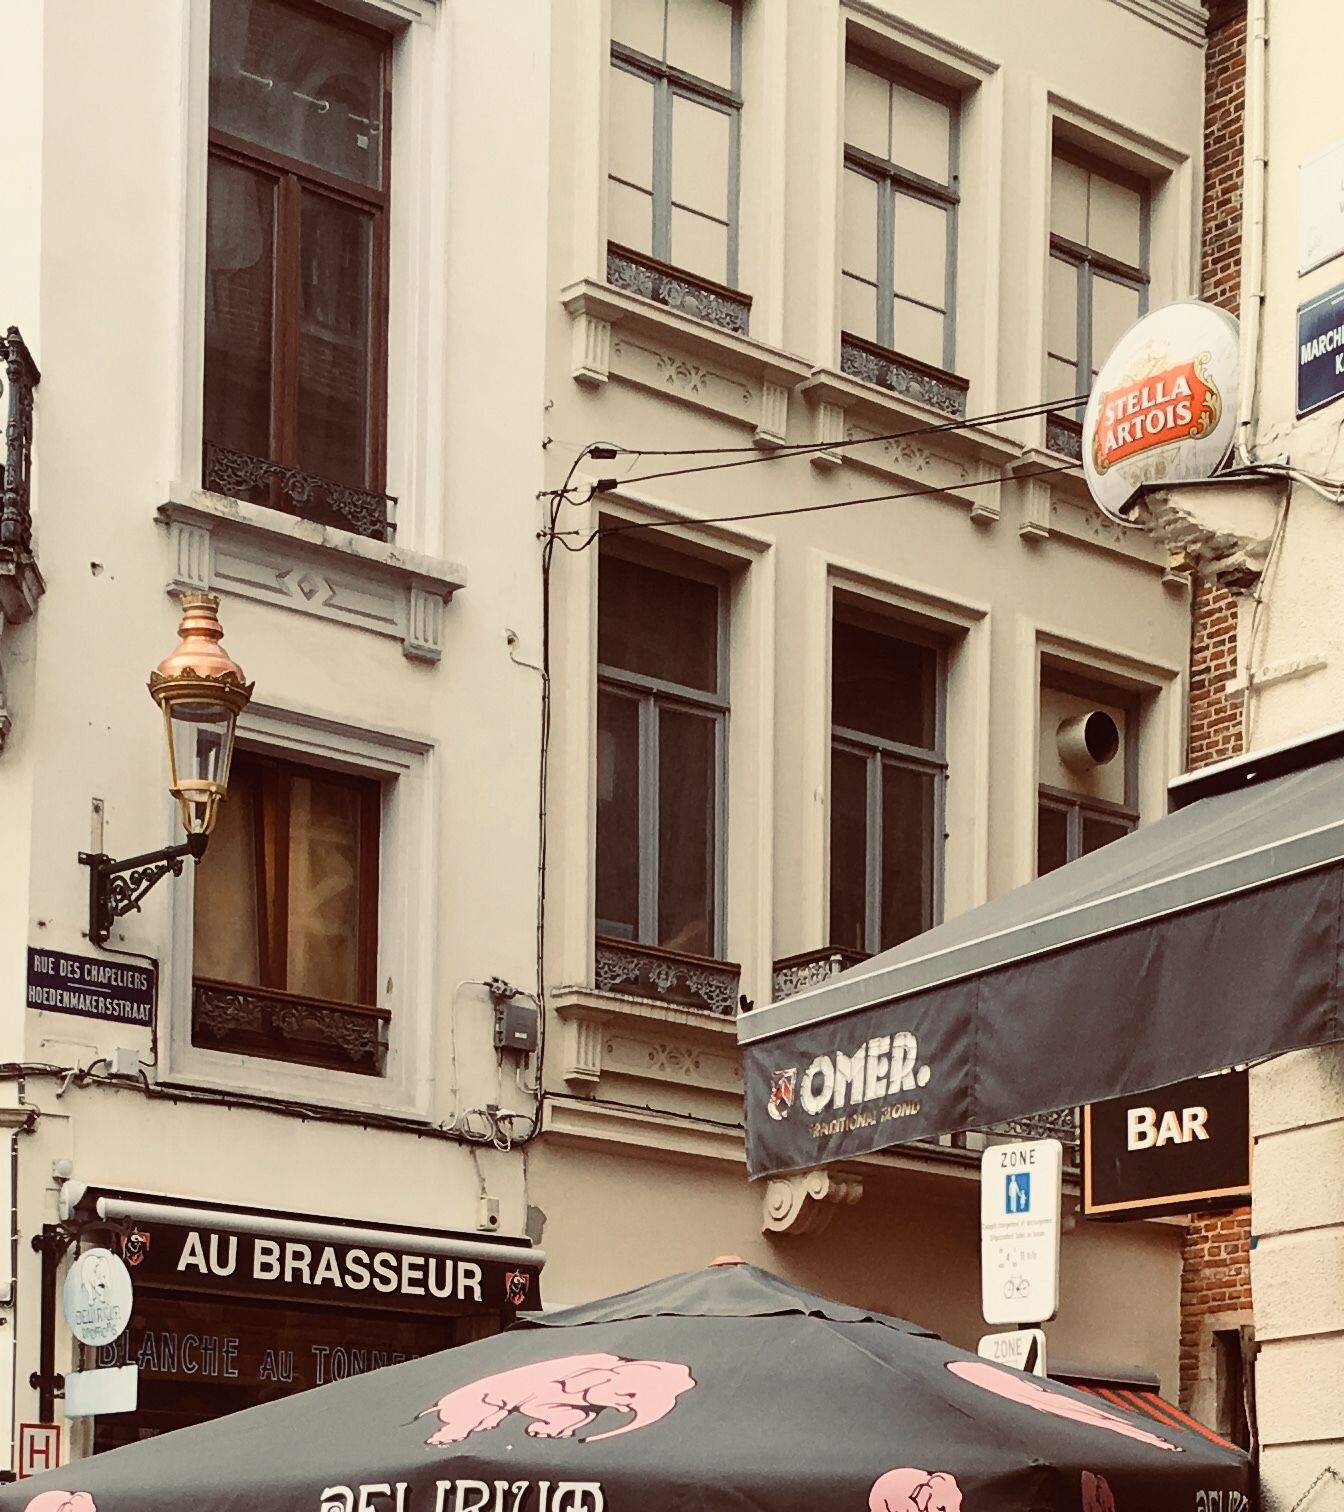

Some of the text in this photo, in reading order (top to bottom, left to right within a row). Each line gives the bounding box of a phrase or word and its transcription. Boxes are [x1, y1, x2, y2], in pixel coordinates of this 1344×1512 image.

[1103, 375, 1192, 428] STELLA
[1102, 400, 1194, 455] ARTOIS
[33, 954, 148, 991] RUE DES CHAPELIERS
[28, 985, 152, 1023] HOEDENMAKERSSTRAAT
[1000, 1149, 1036, 1168] ZONE
[176, 1230, 484, 1302] AU BRASSEUR
[259, 1349, 295, 1383] AU
[993, 1338, 1023, 1359] ZONE
[29, 1435, 49, 1470] H
